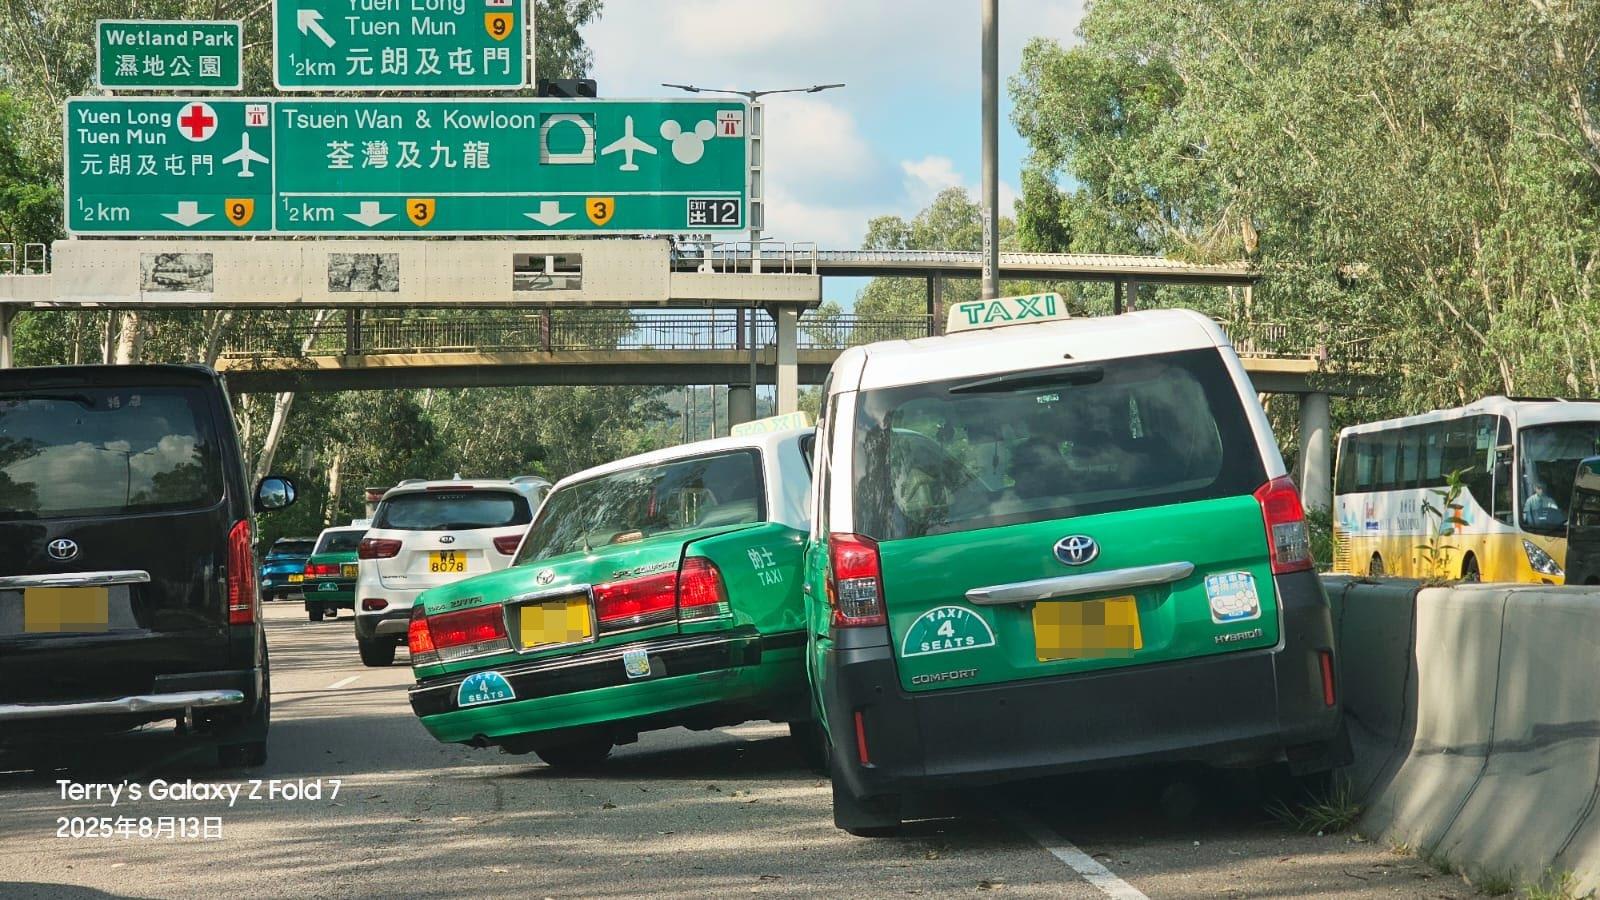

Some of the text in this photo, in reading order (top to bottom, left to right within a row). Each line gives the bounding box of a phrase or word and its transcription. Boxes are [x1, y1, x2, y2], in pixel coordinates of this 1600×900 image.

[345, 16, 456, 35] Tuen Mun
[492, 18, 505, 35] 9
[106, 30, 234, 46] Wetland Park
[115, 55, 221, 77] 濕地公園
[346, 47, 510, 75] 元朗及屯門
[78, 109, 171, 128] Yuen Long
[283, 110, 536, 128] Tsuen Wan & Kowloon
[77, 129, 166, 145] Tuen Mun
[326, 141, 491, 169] 荃灣及九龍
[80, 154, 214, 175] 元朗及屯門
[232, 204, 245, 219] 9
[414, 203, 428, 219] 3
[593, 203, 606, 219] 3
[690, 201, 706, 210] EXIT
[709, 202, 736, 223] 12
[690, 211, 706, 223] 出
[960, 295, 1056, 325] TAXI
[440, 552, 455, 562] WA
[747, 547, 776, 570] 的士
[431, 562, 463, 572] 8078
[757, 568, 783, 586] TAXI
[926, 608, 962, 622] TAXI
[938, 620, 954, 638] 4
[921, 635, 975, 651] SEATS
[468, 674, 497, 685] TAXI
[912, 669, 977, 684] COMFORT
[479, 680, 488, 693] 4
[469, 690, 504, 702] SEATS
